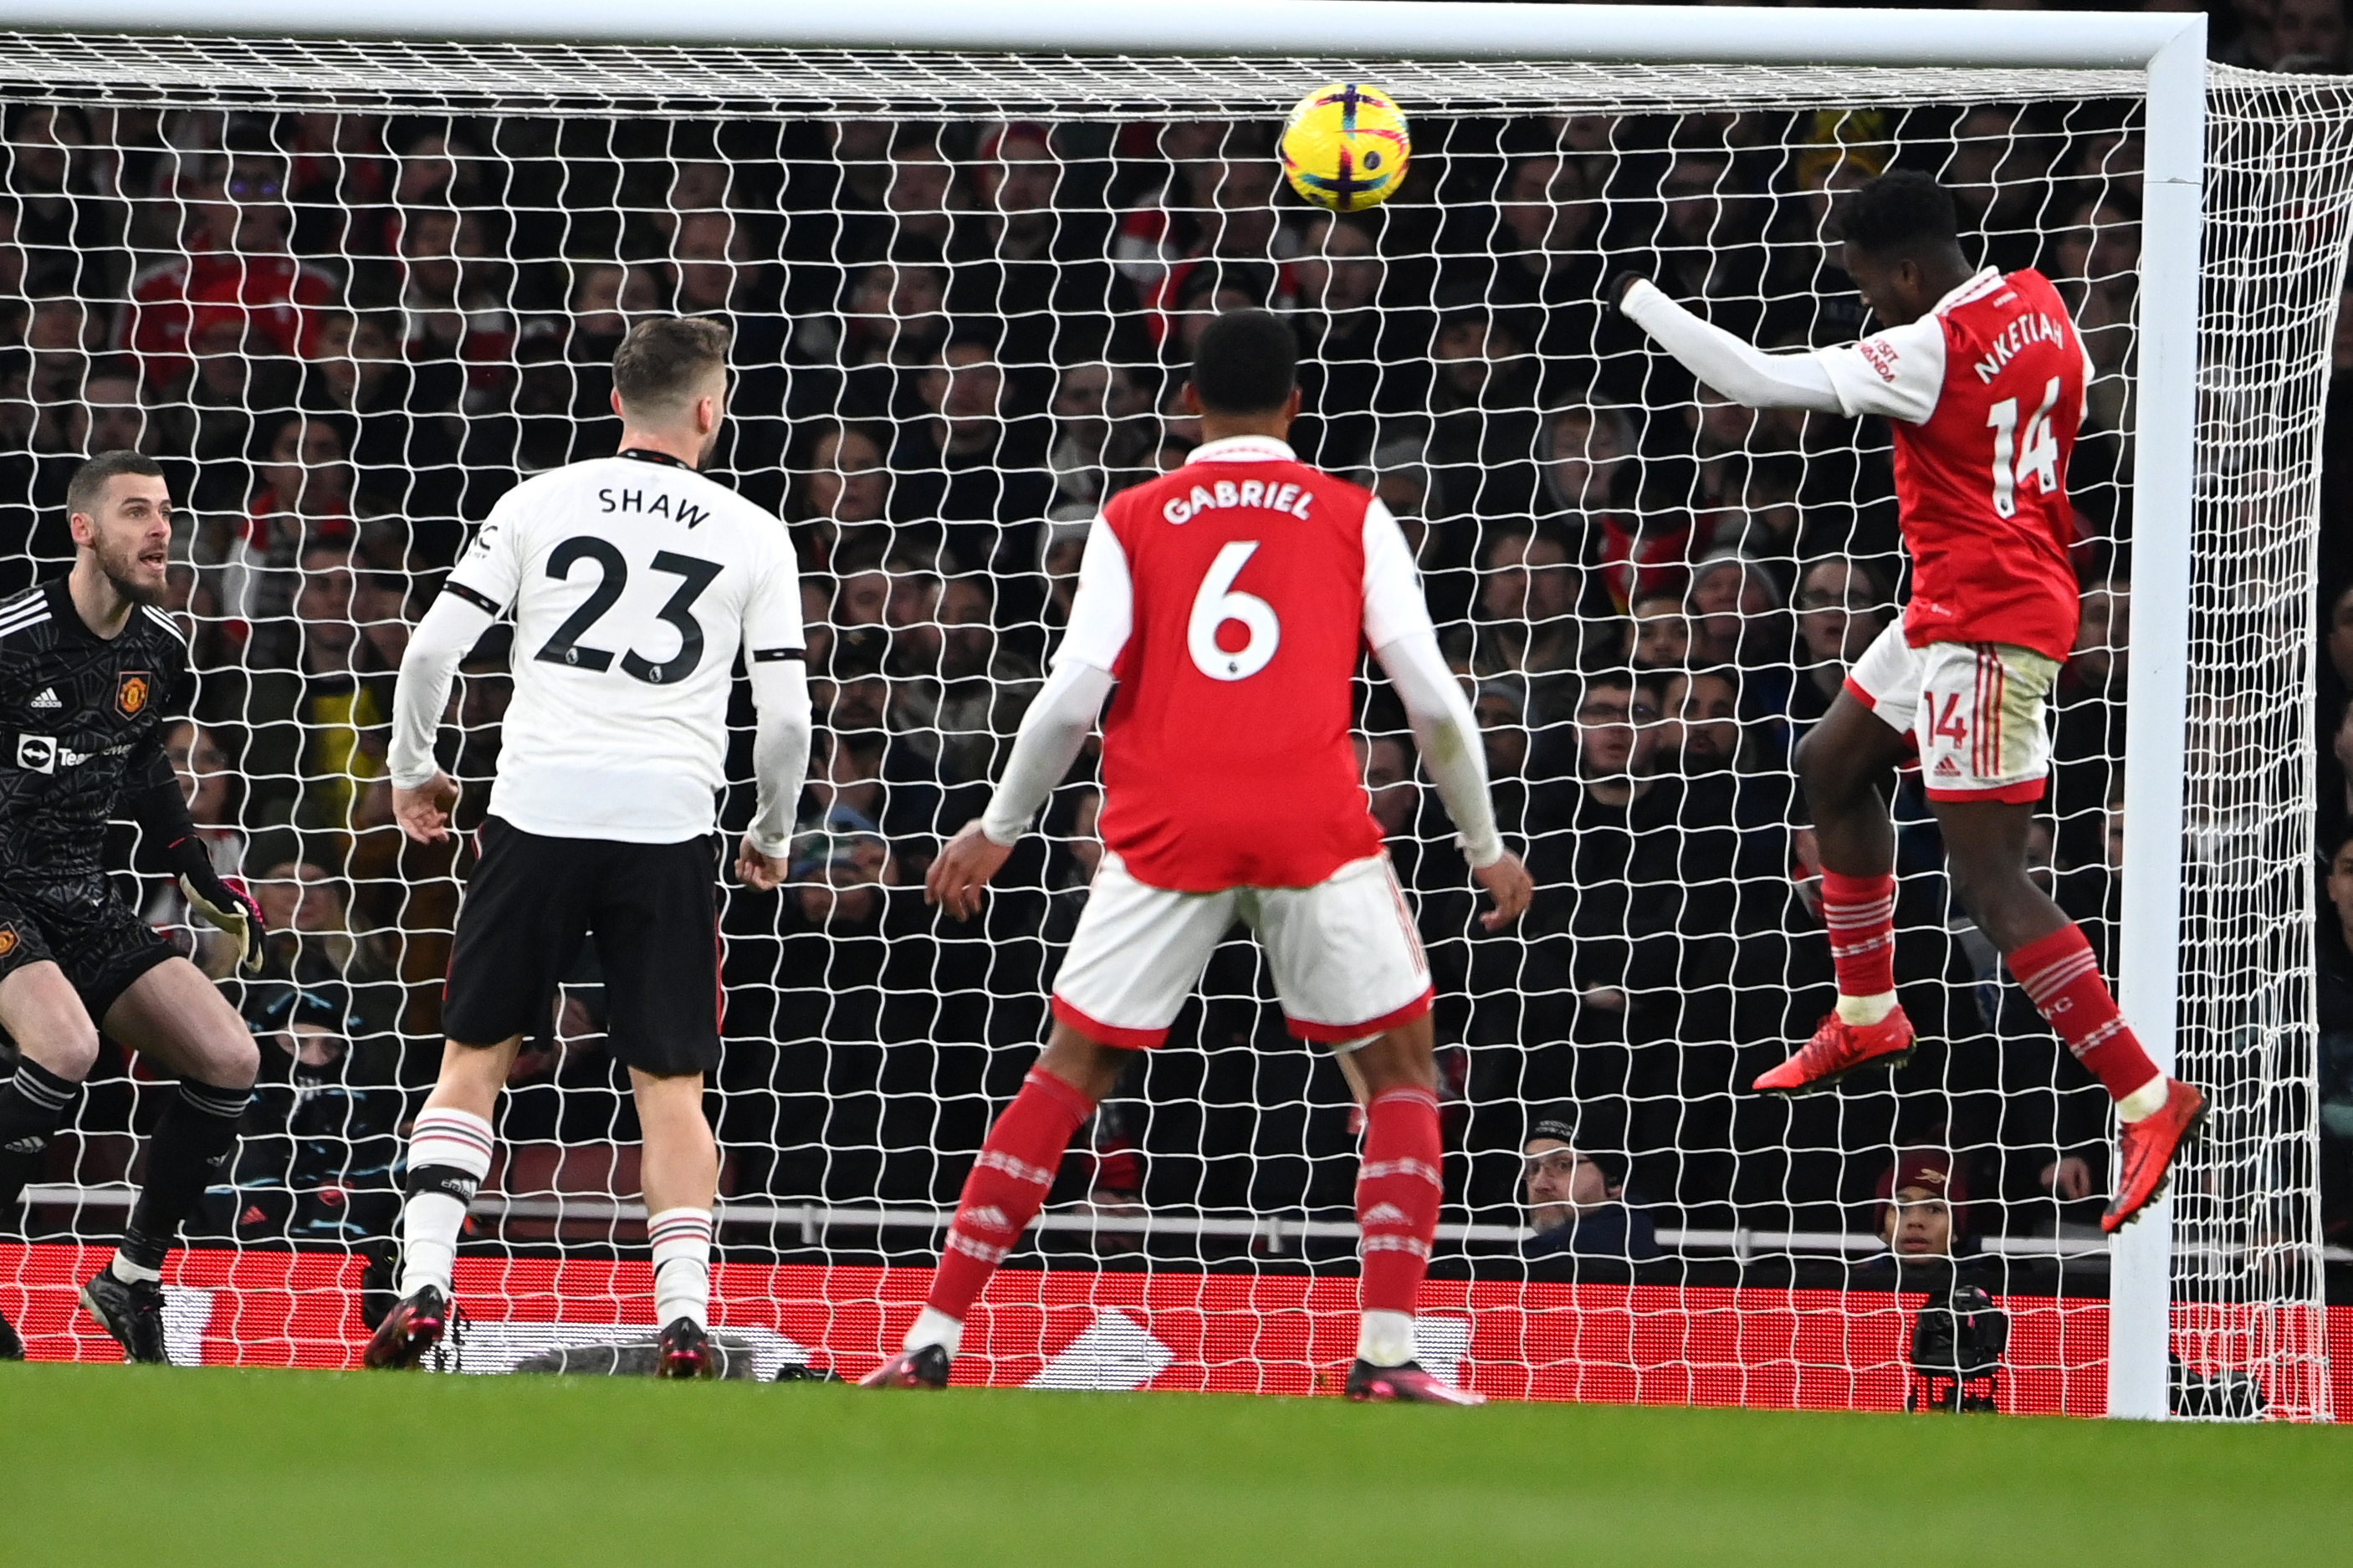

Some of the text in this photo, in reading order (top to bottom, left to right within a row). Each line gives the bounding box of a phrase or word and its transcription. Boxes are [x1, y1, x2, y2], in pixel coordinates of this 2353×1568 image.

[1858, 343, 1896, 383] WANDA
[1974, 313, 2064, 385] NKETIAH
[1987, 375, 2060, 519] 14
[599, 488, 710, 529] SHAW
[1163, 479, 1314, 525] GABRIEL
[534, 535, 725, 685] 23
[1187, 540, 1281, 682] 6
[1924, 691, 1968, 749] 14
